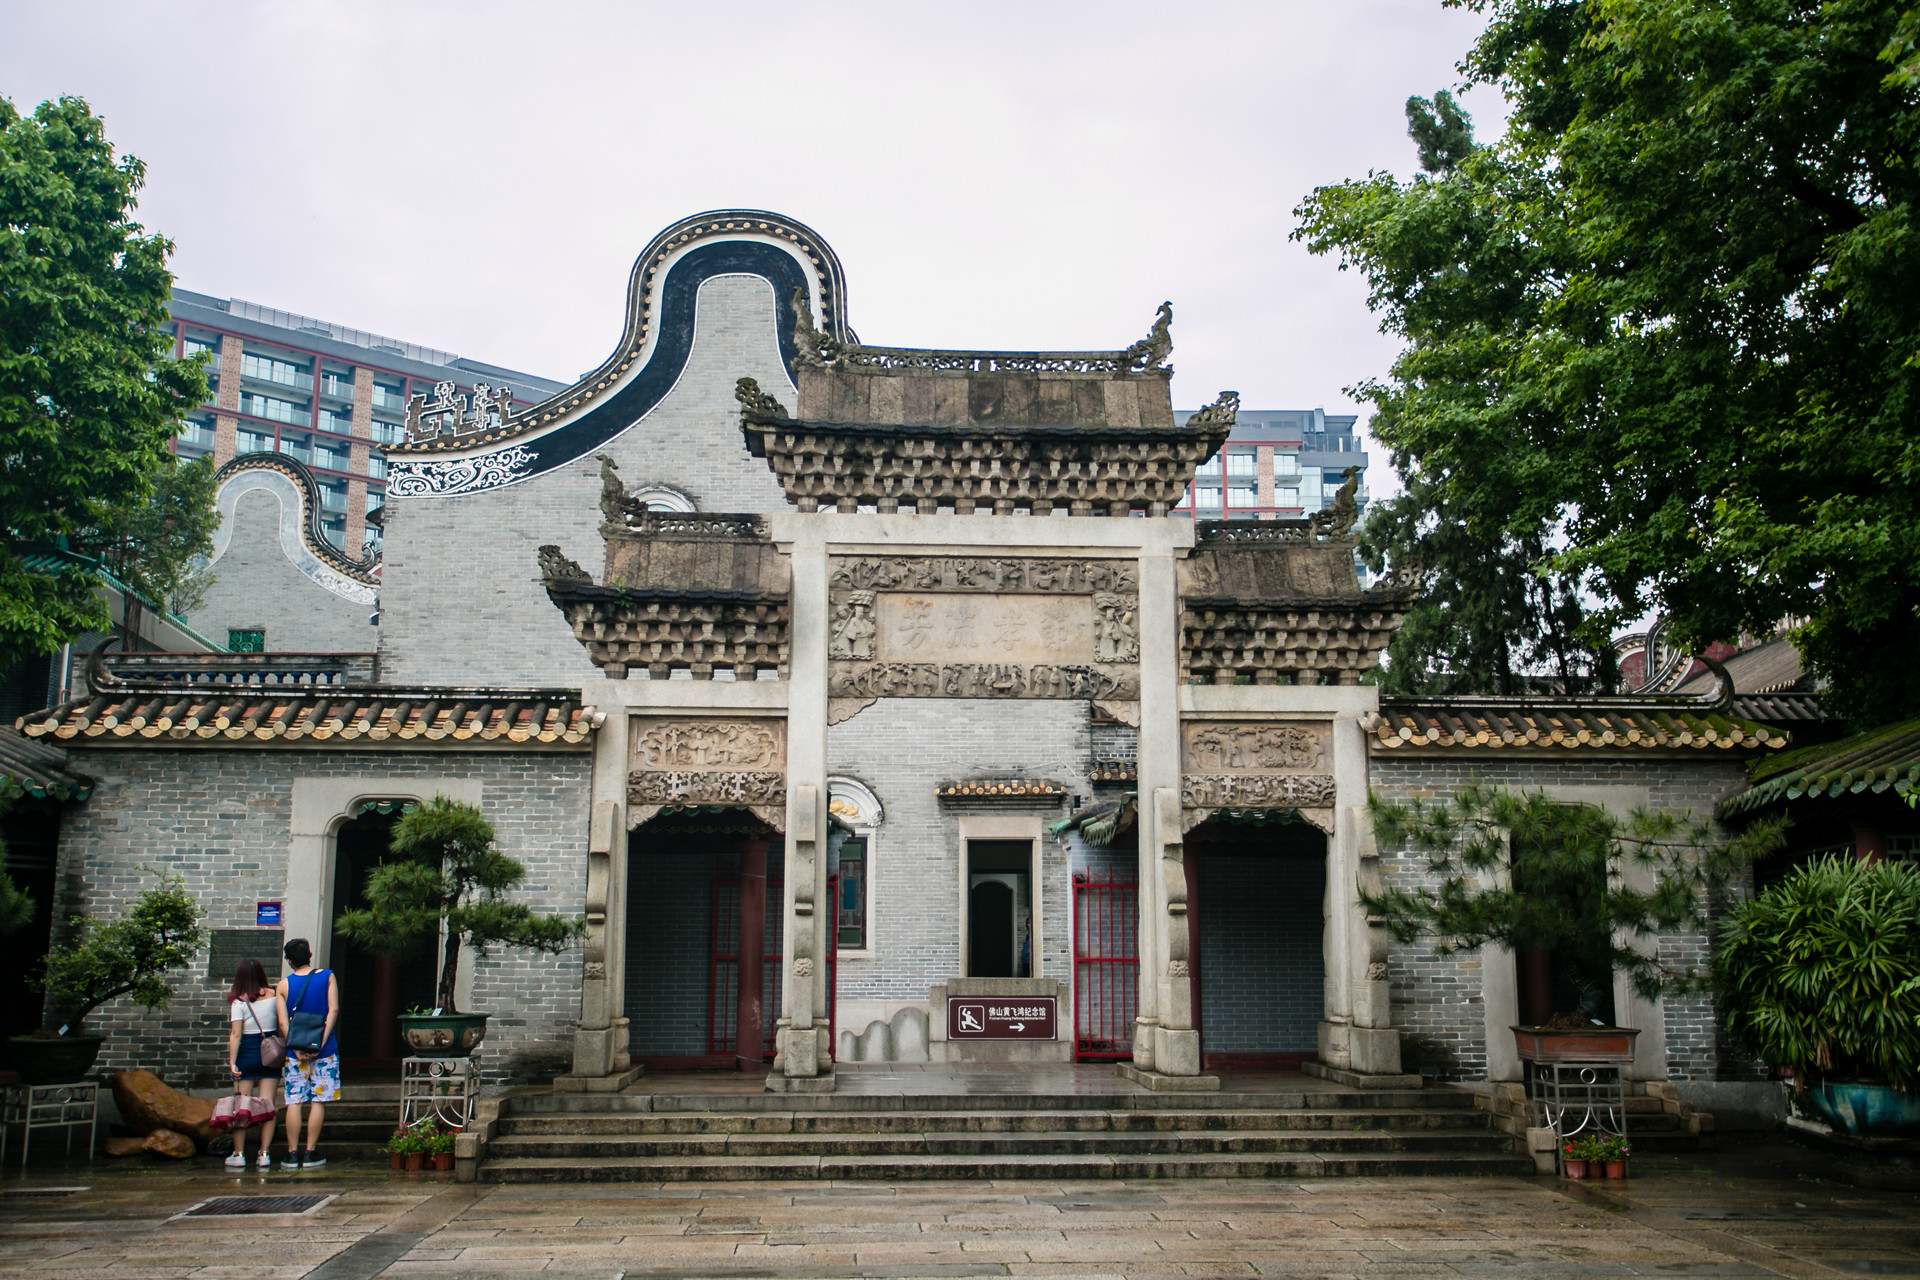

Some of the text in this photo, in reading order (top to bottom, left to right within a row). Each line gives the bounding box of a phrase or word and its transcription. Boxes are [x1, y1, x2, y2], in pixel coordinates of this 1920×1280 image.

[989, 1007, 1046, 1016] 佛山黄飞鸿纪念馆
